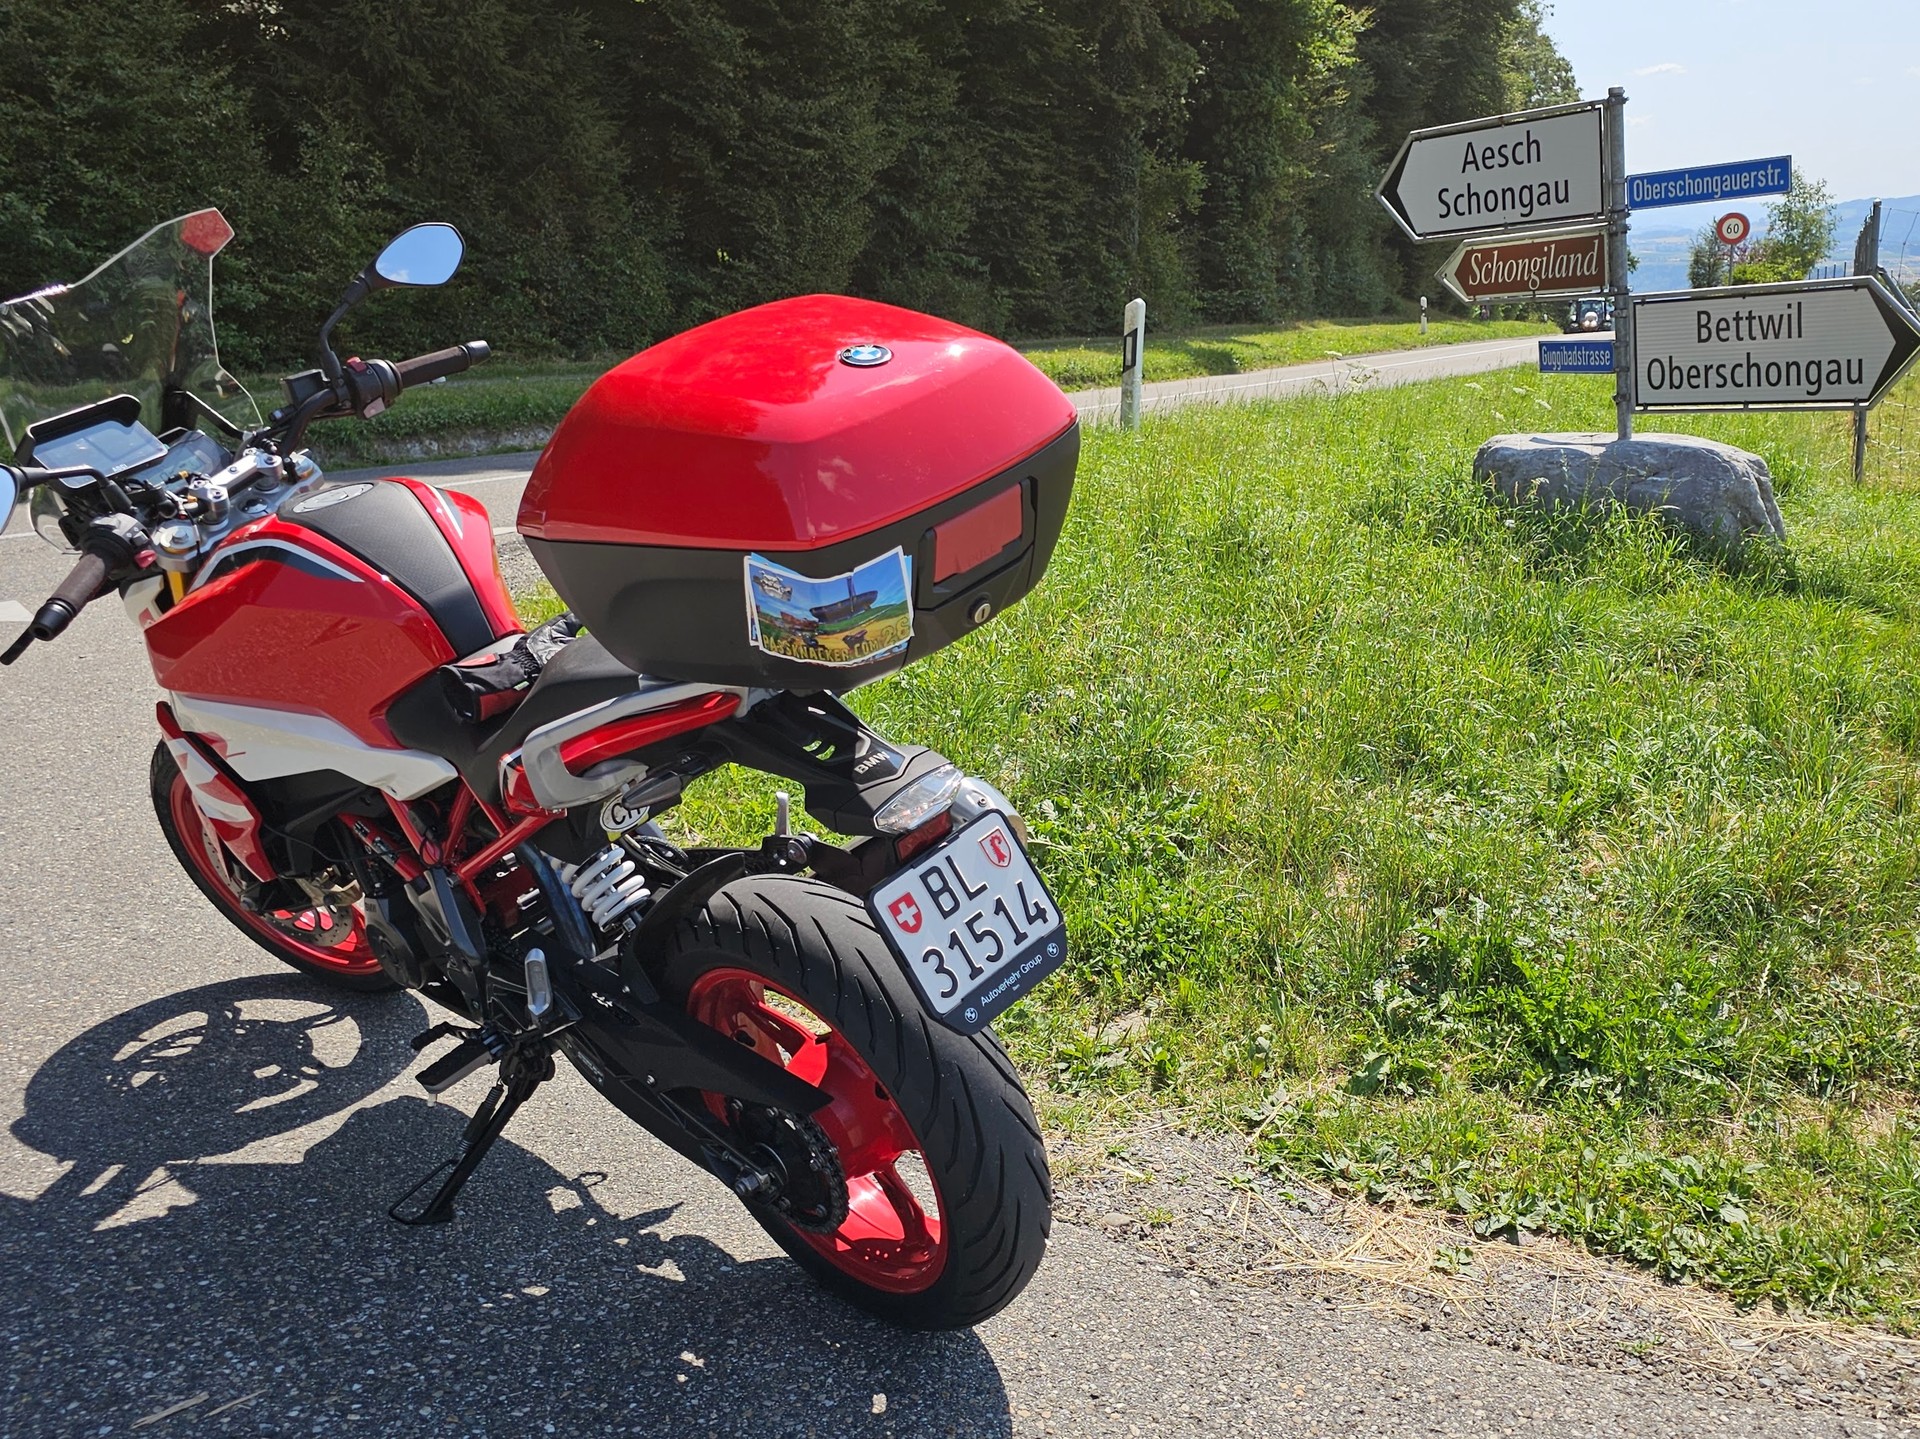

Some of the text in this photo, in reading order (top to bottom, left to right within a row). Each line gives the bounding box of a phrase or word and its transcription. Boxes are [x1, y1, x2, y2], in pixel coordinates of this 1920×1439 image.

[1462, 130, 1541, 173] Aesch
[1438, 179, 1570, 219] Schongau
[1633, 164, 1784, 201] Oberschongauerstr.
[1726, 223, 1740, 234] 60
[1469, 239, 1599, 290] Schongiland
[1697, 301, 1802, 343] Bettwil
[1542, 345, 1611, 370] Guggibadstrasse
[1647, 352, 1863, 396] Oberschongau
[854, 750, 890, 775] BMW
[919, 855, 988, 920] BL
[922, 879, 1049, 998] 31514
[980, 954, 1042, 1006] Autoverkehr Group
